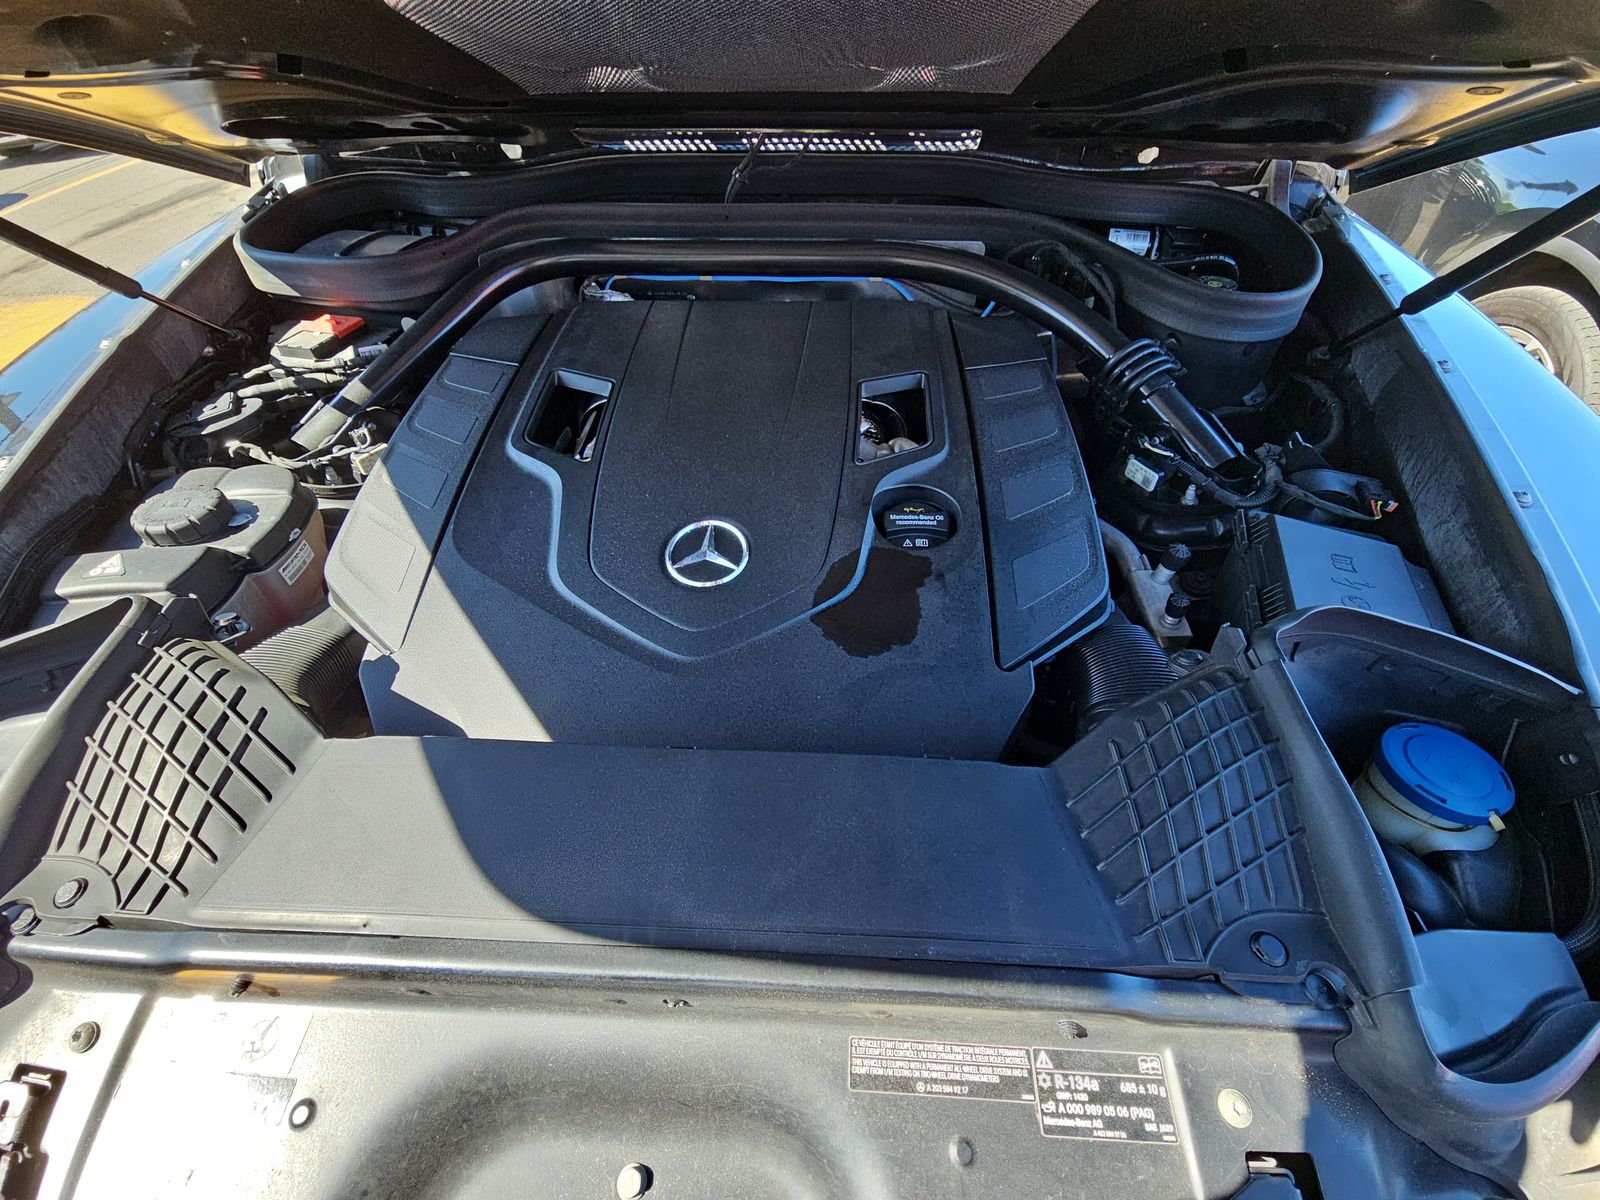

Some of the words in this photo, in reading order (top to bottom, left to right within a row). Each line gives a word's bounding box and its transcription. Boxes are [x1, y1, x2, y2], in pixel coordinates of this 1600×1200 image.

[1054, 1073, 1100, 1091] R-134a
[961, 1086, 968, 1094] 17
[1147, 1084, 1158, 1095] 10
[1059, 1102, 1066, 1113] A
[1066, 1103, 1084, 1114] 000
[1085, 1104, 1102, 1116] 989
[1103, 1105, 1115, 1116] 05
[1117, 1106, 1129, 1117] 06
[1130, 1106, 1155, 1121] (PAG)
[1043, 1116, 1092, 1128] Mercedes-Benz
